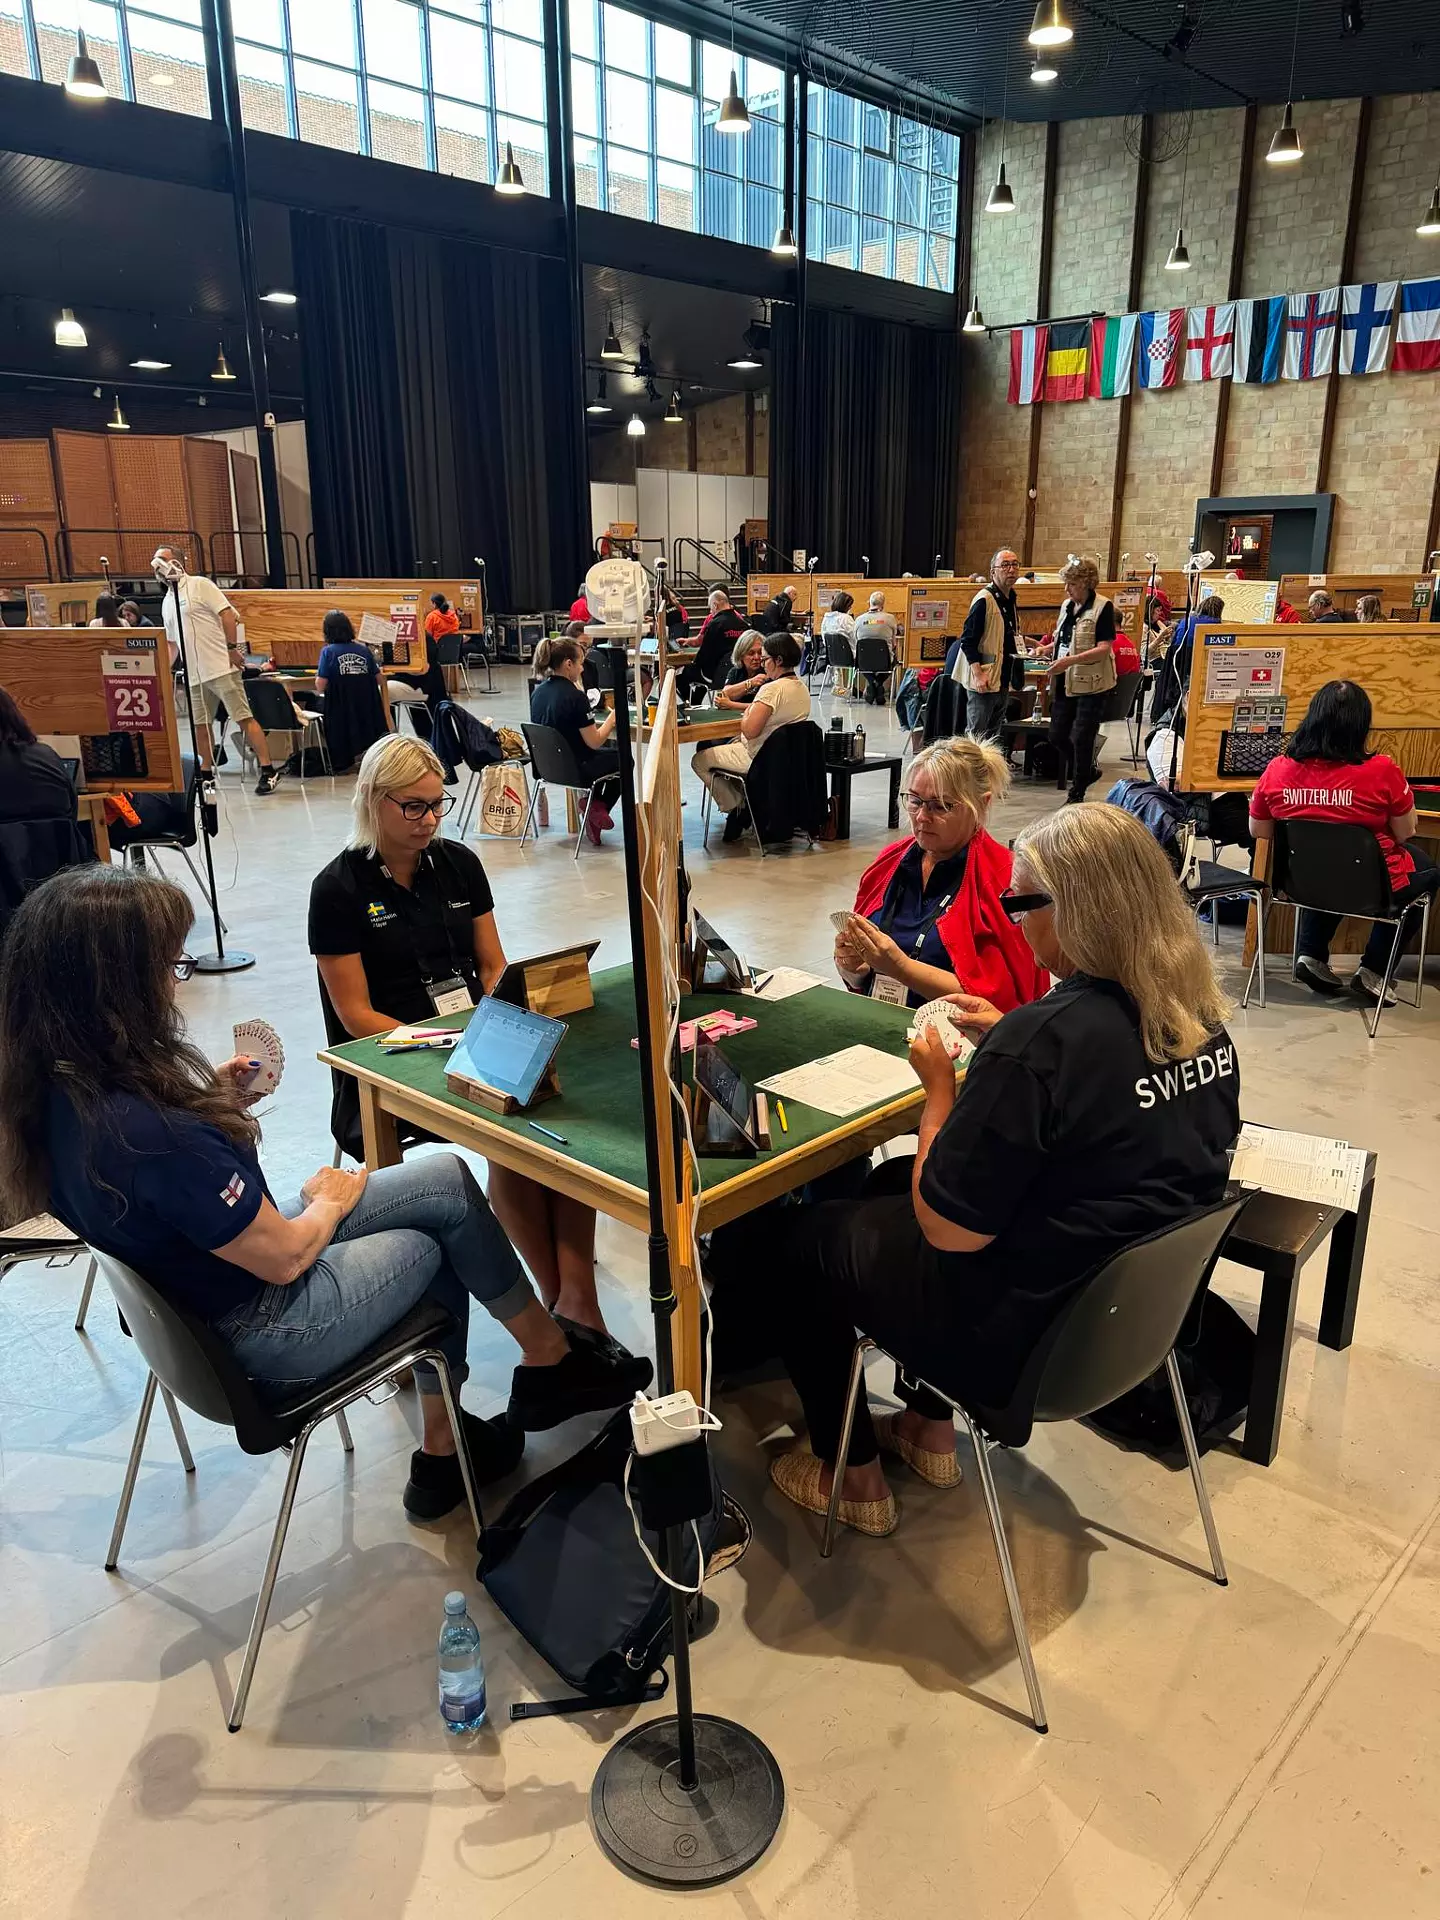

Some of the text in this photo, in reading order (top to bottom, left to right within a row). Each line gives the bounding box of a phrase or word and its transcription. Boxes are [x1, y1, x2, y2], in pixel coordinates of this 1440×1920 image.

[463, 596, 475, 608] 64
[1414, 592, 1427, 604] 41
[396, 620, 413, 635] 27
[127, 639, 156, 647] SOUTH
[1209, 636, 1232, 644] EAST
[114, 688, 151, 717] 23
[1283, 788, 1353, 806] SWITZERLAND
